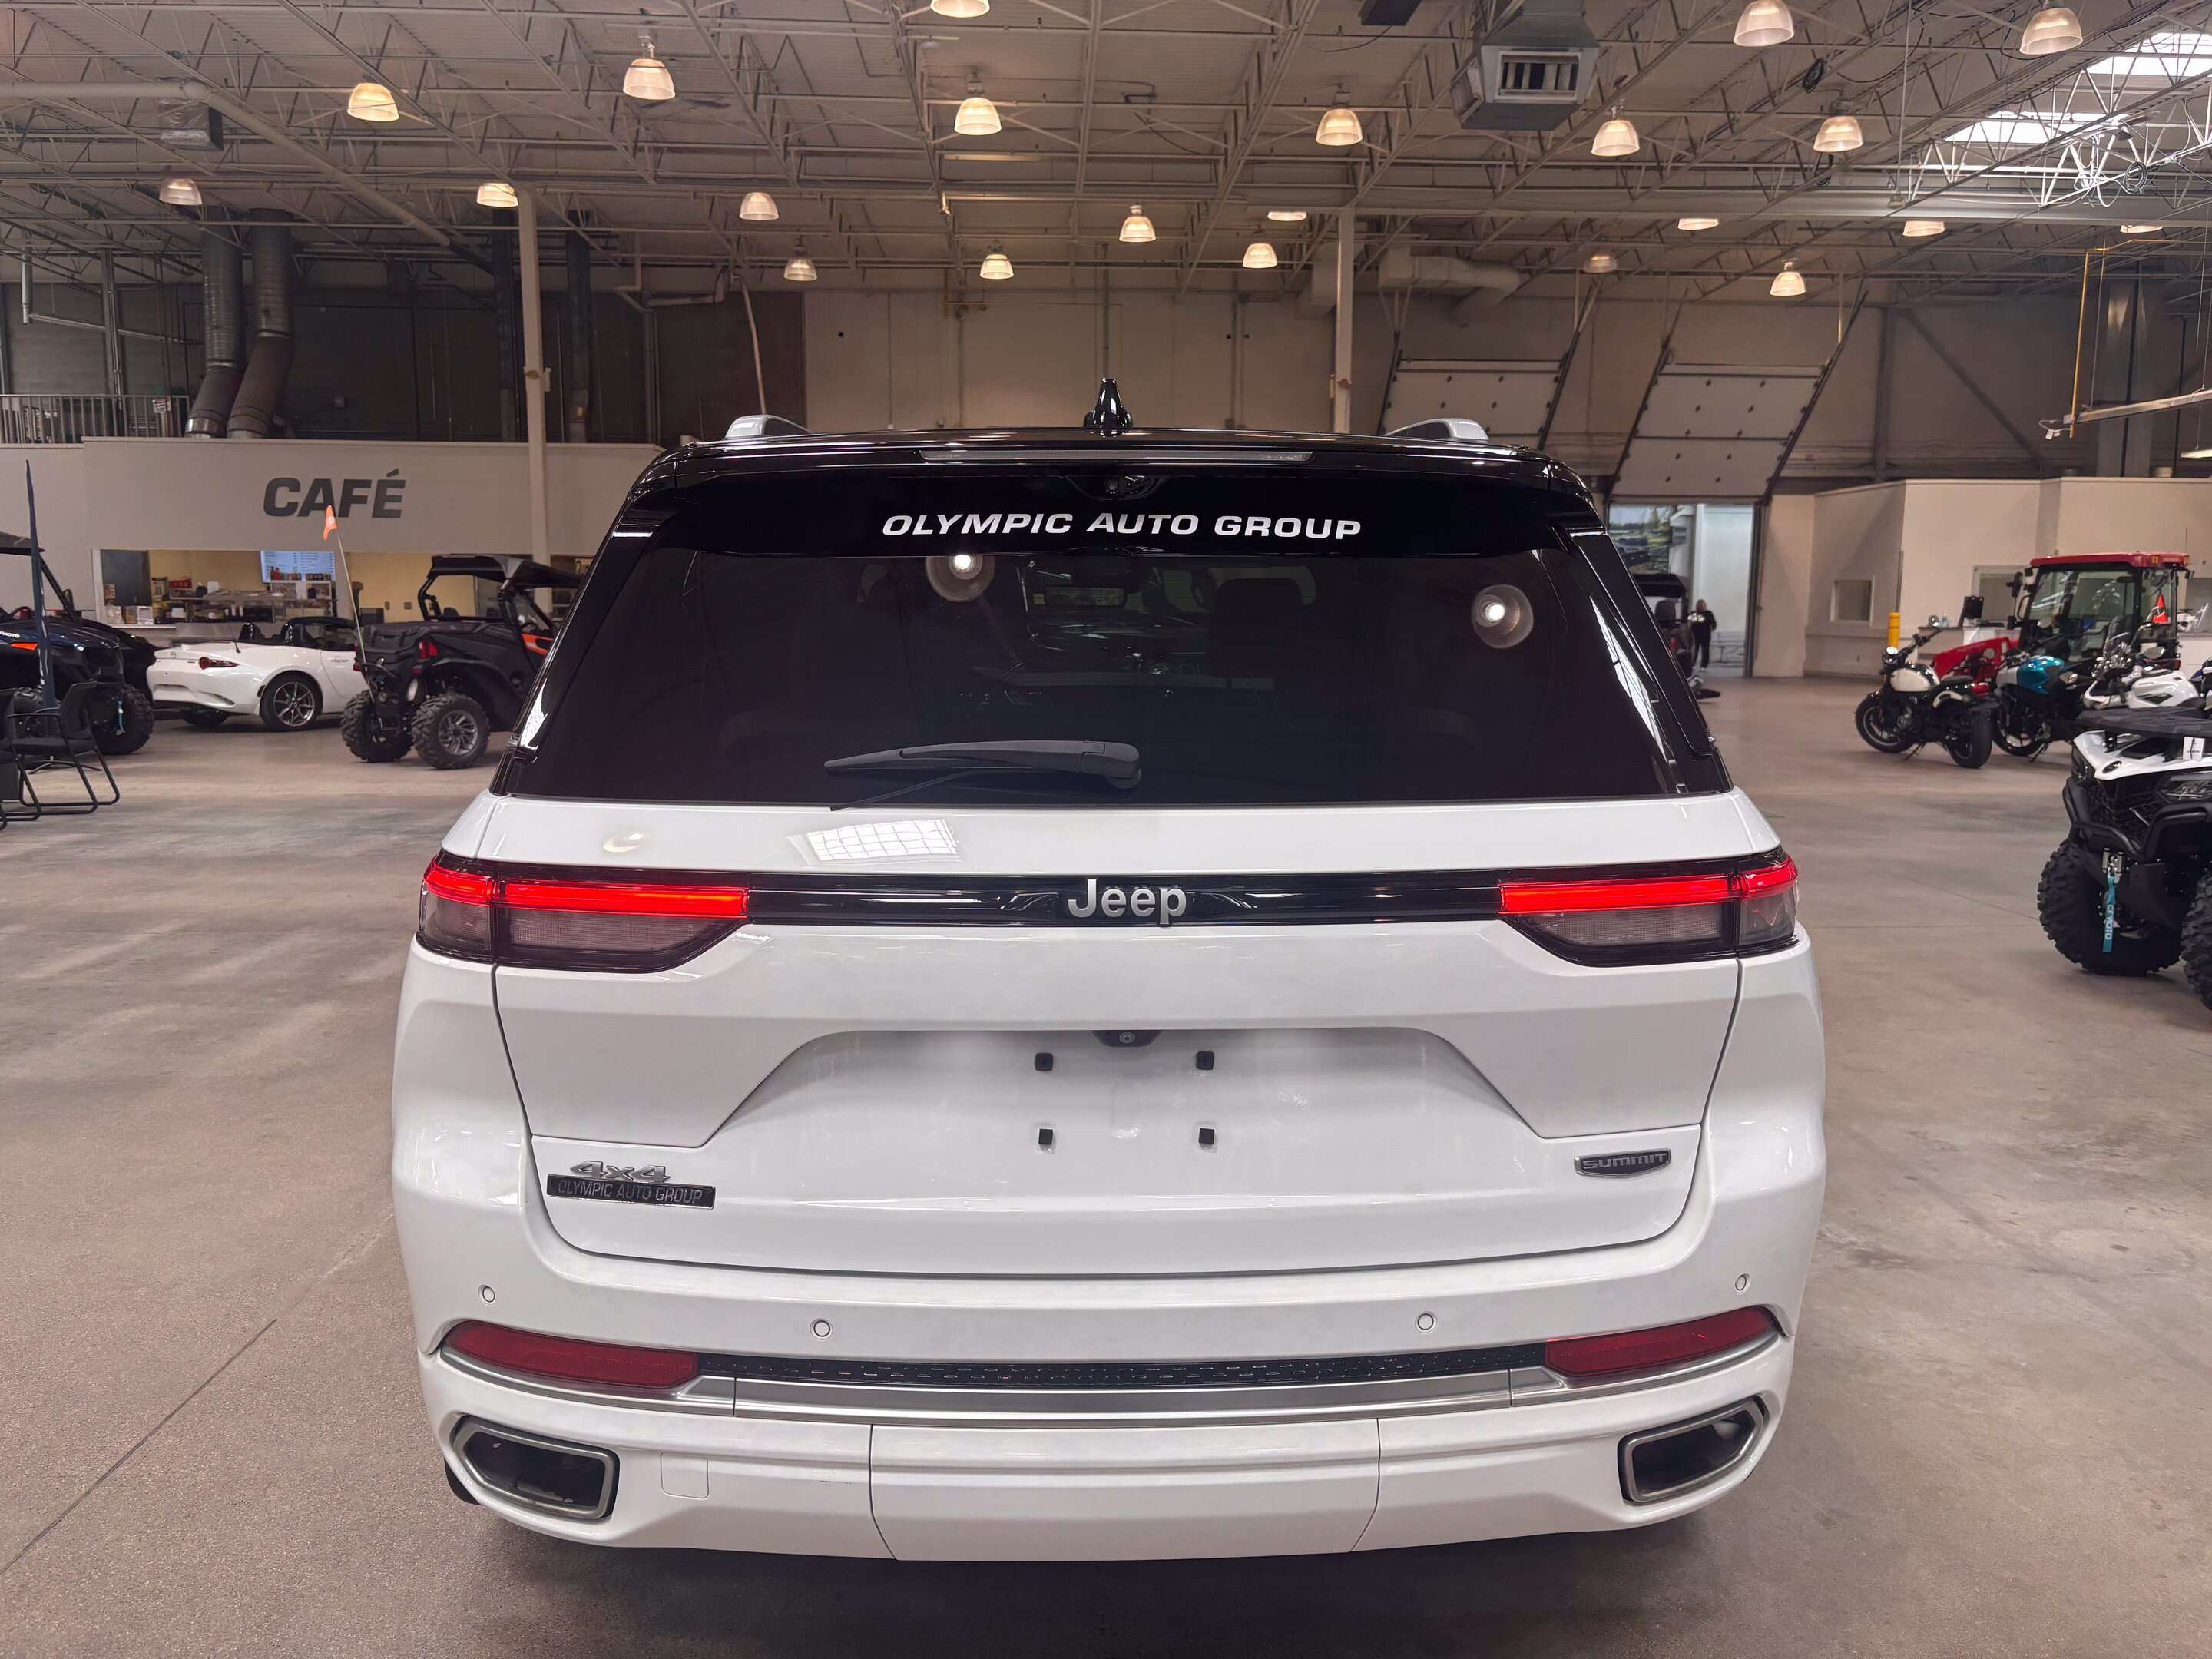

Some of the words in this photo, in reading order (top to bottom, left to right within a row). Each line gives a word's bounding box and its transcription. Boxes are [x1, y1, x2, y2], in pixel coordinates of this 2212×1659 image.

[263, 469, 406, 518] CAFÉ
[882, 513, 1073, 536] OLYMPIC
[1086, 512, 1199, 535] AUTO
[1214, 515, 1361, 540] GROUP
[1068, 879, 1187, 925] Jeep
[570, 1160, 671, 1184] 4x4
[1583, 1154, 1667, 1169] SUMMIT
[558, 1180, 613, 1197] OLYMPIC
[614, 1184, 652, 1200] AUTO
[654, 1186, 703, 1204] GROUP
